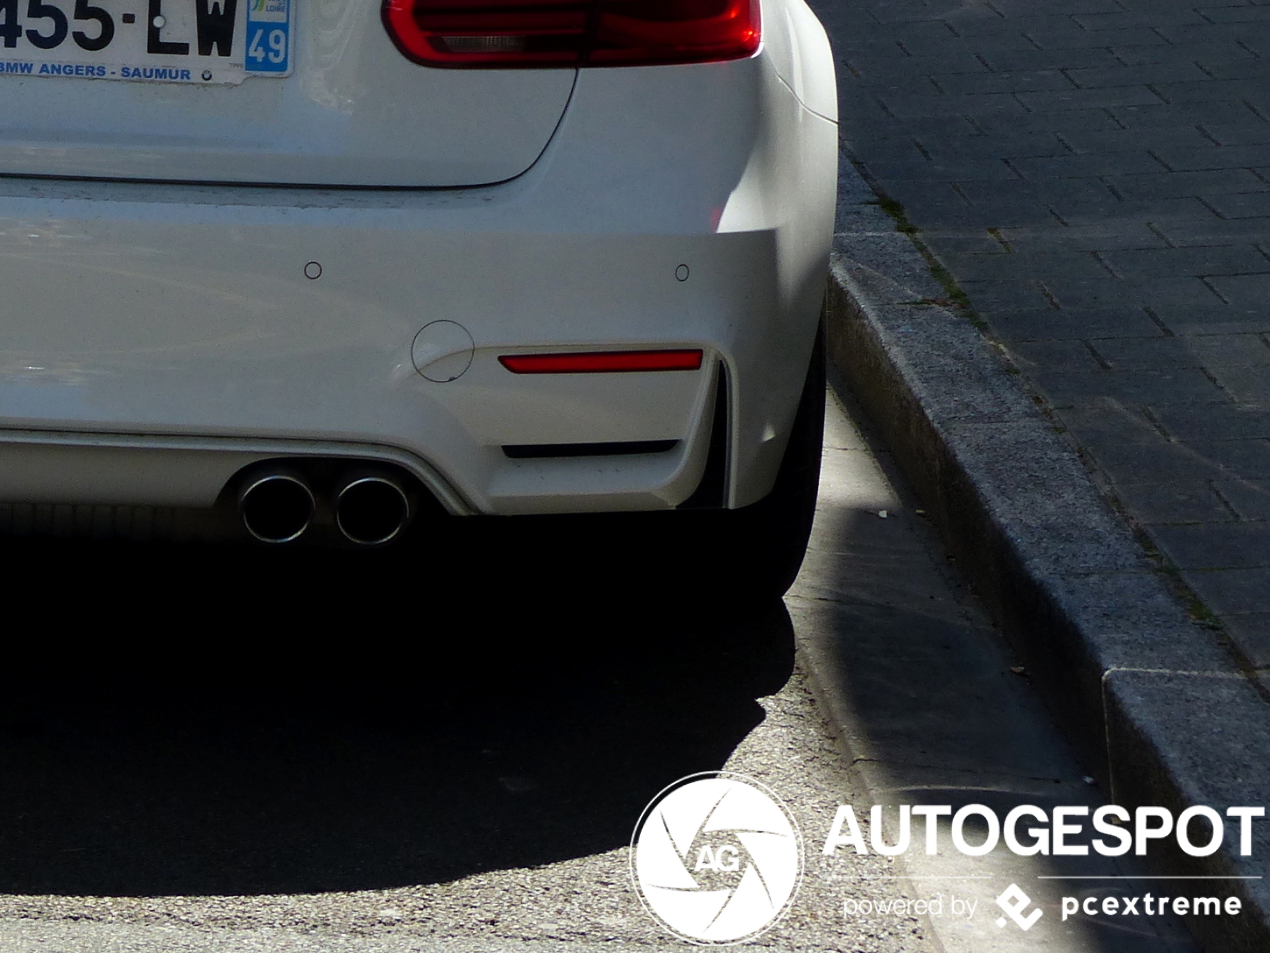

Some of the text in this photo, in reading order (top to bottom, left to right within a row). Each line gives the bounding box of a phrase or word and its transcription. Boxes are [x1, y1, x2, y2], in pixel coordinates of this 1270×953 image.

[248, 29, 286, 64] 49
[39, 63, 106, 77] ANGERS
[121, 66, 191, 80] SAUMUR
